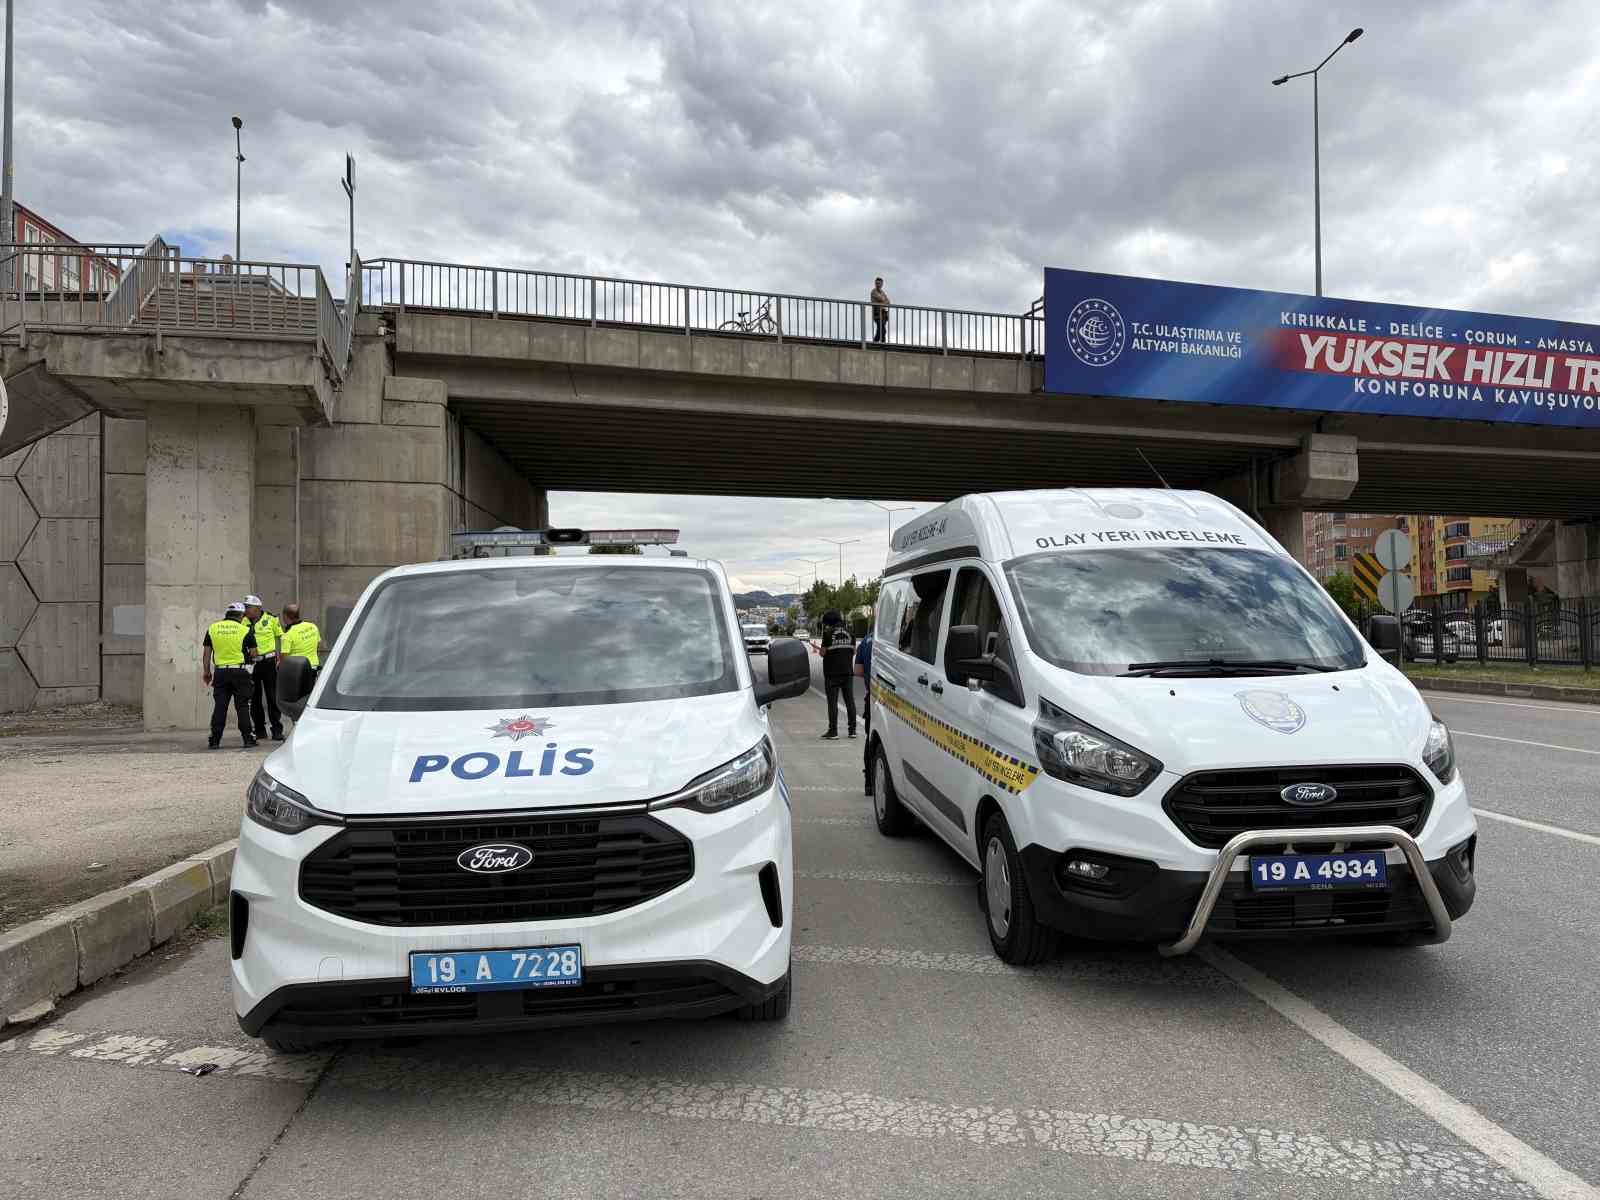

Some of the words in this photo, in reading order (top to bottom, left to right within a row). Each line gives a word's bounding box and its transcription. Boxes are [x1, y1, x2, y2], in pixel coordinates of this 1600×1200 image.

[1131, 322, 1153, 336] T.C.
[1155, 324, 1224, 342] ULAŞTIRMA
[1226, 331, 1241, 344] VE
[1280, 311, 1367, 332] KIRIKKALE
[1390, 321, 1443, 339] DELİCE
[1464, 329, 1517, 346] ÇORUM
[1537, 338, 1594, 354] AMASYA
[1131, 338, 1179, 354] ALTYAPI
[1181, 342, 1241, 358] BAKANLIĞI
[1299, 333, 1456, 380] YÜKSEK
[1463, 349, 1555, 389] HIZLI
[1354, 378, 1483, 402] KONFORUNA
[1495, 389, 1600, 411] KAVUŞUYO
[1035, 533, 1088, 549] OLAY
[408, 742, 595, 783] POLİS
[1295, 785, 1326, 801] Ford
[470, 848, 519, 869] Ford
[1258, 861, 1287, 881] 19
[1294, 861, 1311, 880] A
[1318, 859, 1378, 879] 4934
[427, 956, 456, 984] 19
[476, 955, 492, 980] A
[511, 950, 577, 979] 7228
